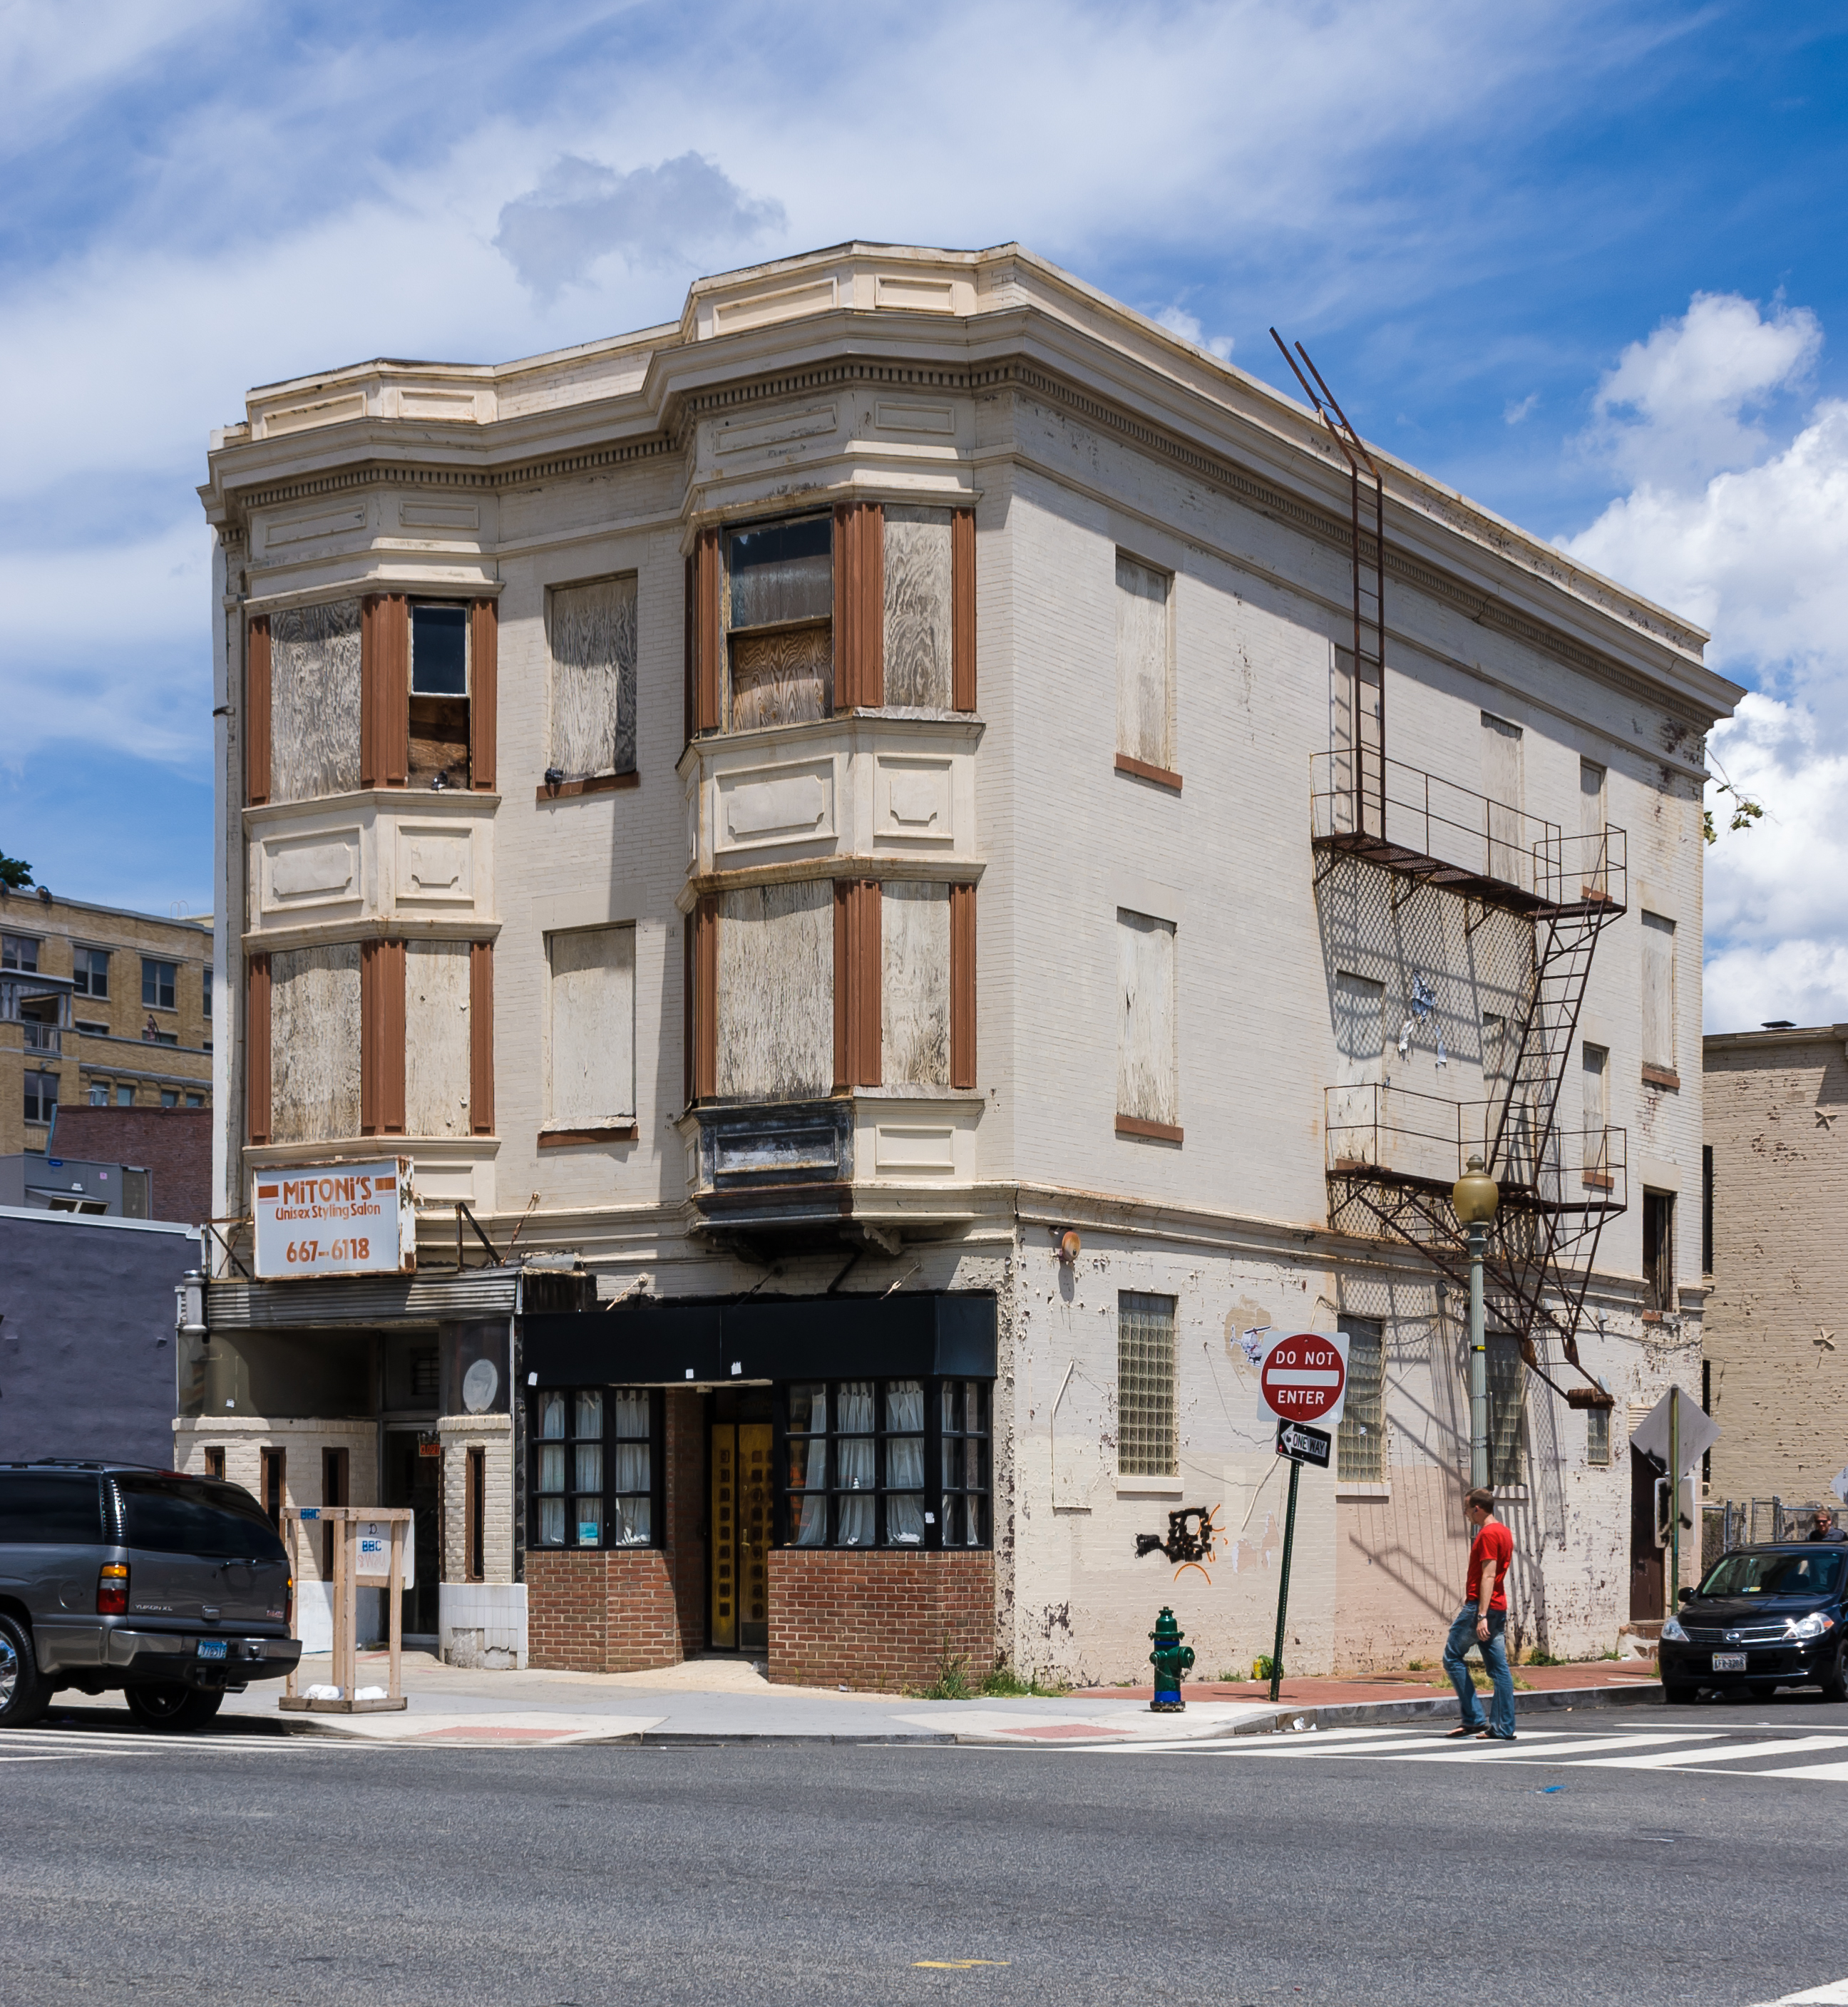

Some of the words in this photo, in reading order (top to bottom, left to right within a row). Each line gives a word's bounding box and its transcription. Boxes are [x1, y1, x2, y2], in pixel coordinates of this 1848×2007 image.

[275, 1206, 310, 1221] Unisex
[312, 1203, 349, 1221] Styling
[351, 1201, 381, 1216] Salon
[286, 1238, 370, 1263] 667-6118
[1275, 1350, 1296, 1365] DO
[1305, 1352, 1335, 1365] NOT
[1278, 1390, 1325, 1405] ENTER
[1293, 1433, 1308, 1450] ONE
[1309, 1438, 1325, 1455] WAY
[300, 1508, 320, 1519] BBC
[362, 1540, 381, 1552] BBC
